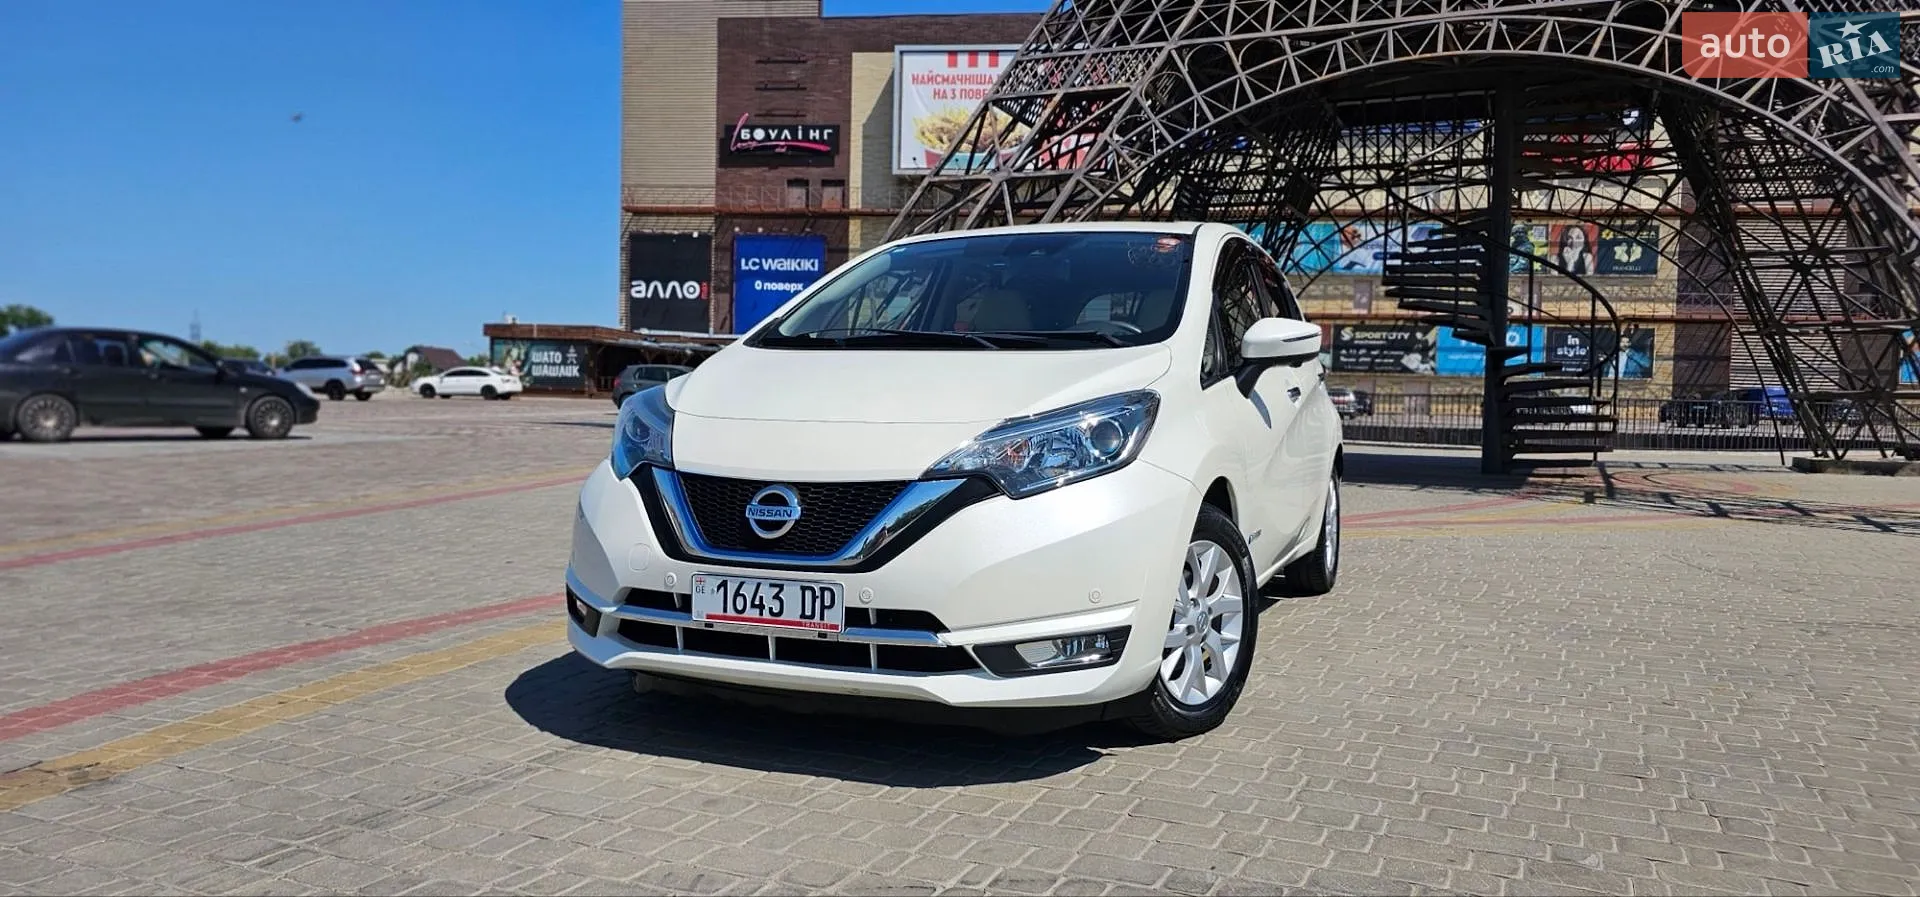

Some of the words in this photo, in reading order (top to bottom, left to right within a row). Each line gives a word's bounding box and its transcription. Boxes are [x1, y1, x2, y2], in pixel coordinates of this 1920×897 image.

[911, 70, 993, 86] НАЙСМАЧНІША
[932, 88, 947, 100] НА
[950, 88, 957, 100] 3
[740, 126, 833, 141] БОУЛІНГ
[740, 257, 760, 271] LC
[763, 282, 804, 294] поверх
[1567, 334, 1580, 346] in
[532, 351, 563, 363] ШАТО
[748, 507, 793, 518] NISSAN
[716, 579, 785, 618] 1643
[800, 585, 836, 621] DP
